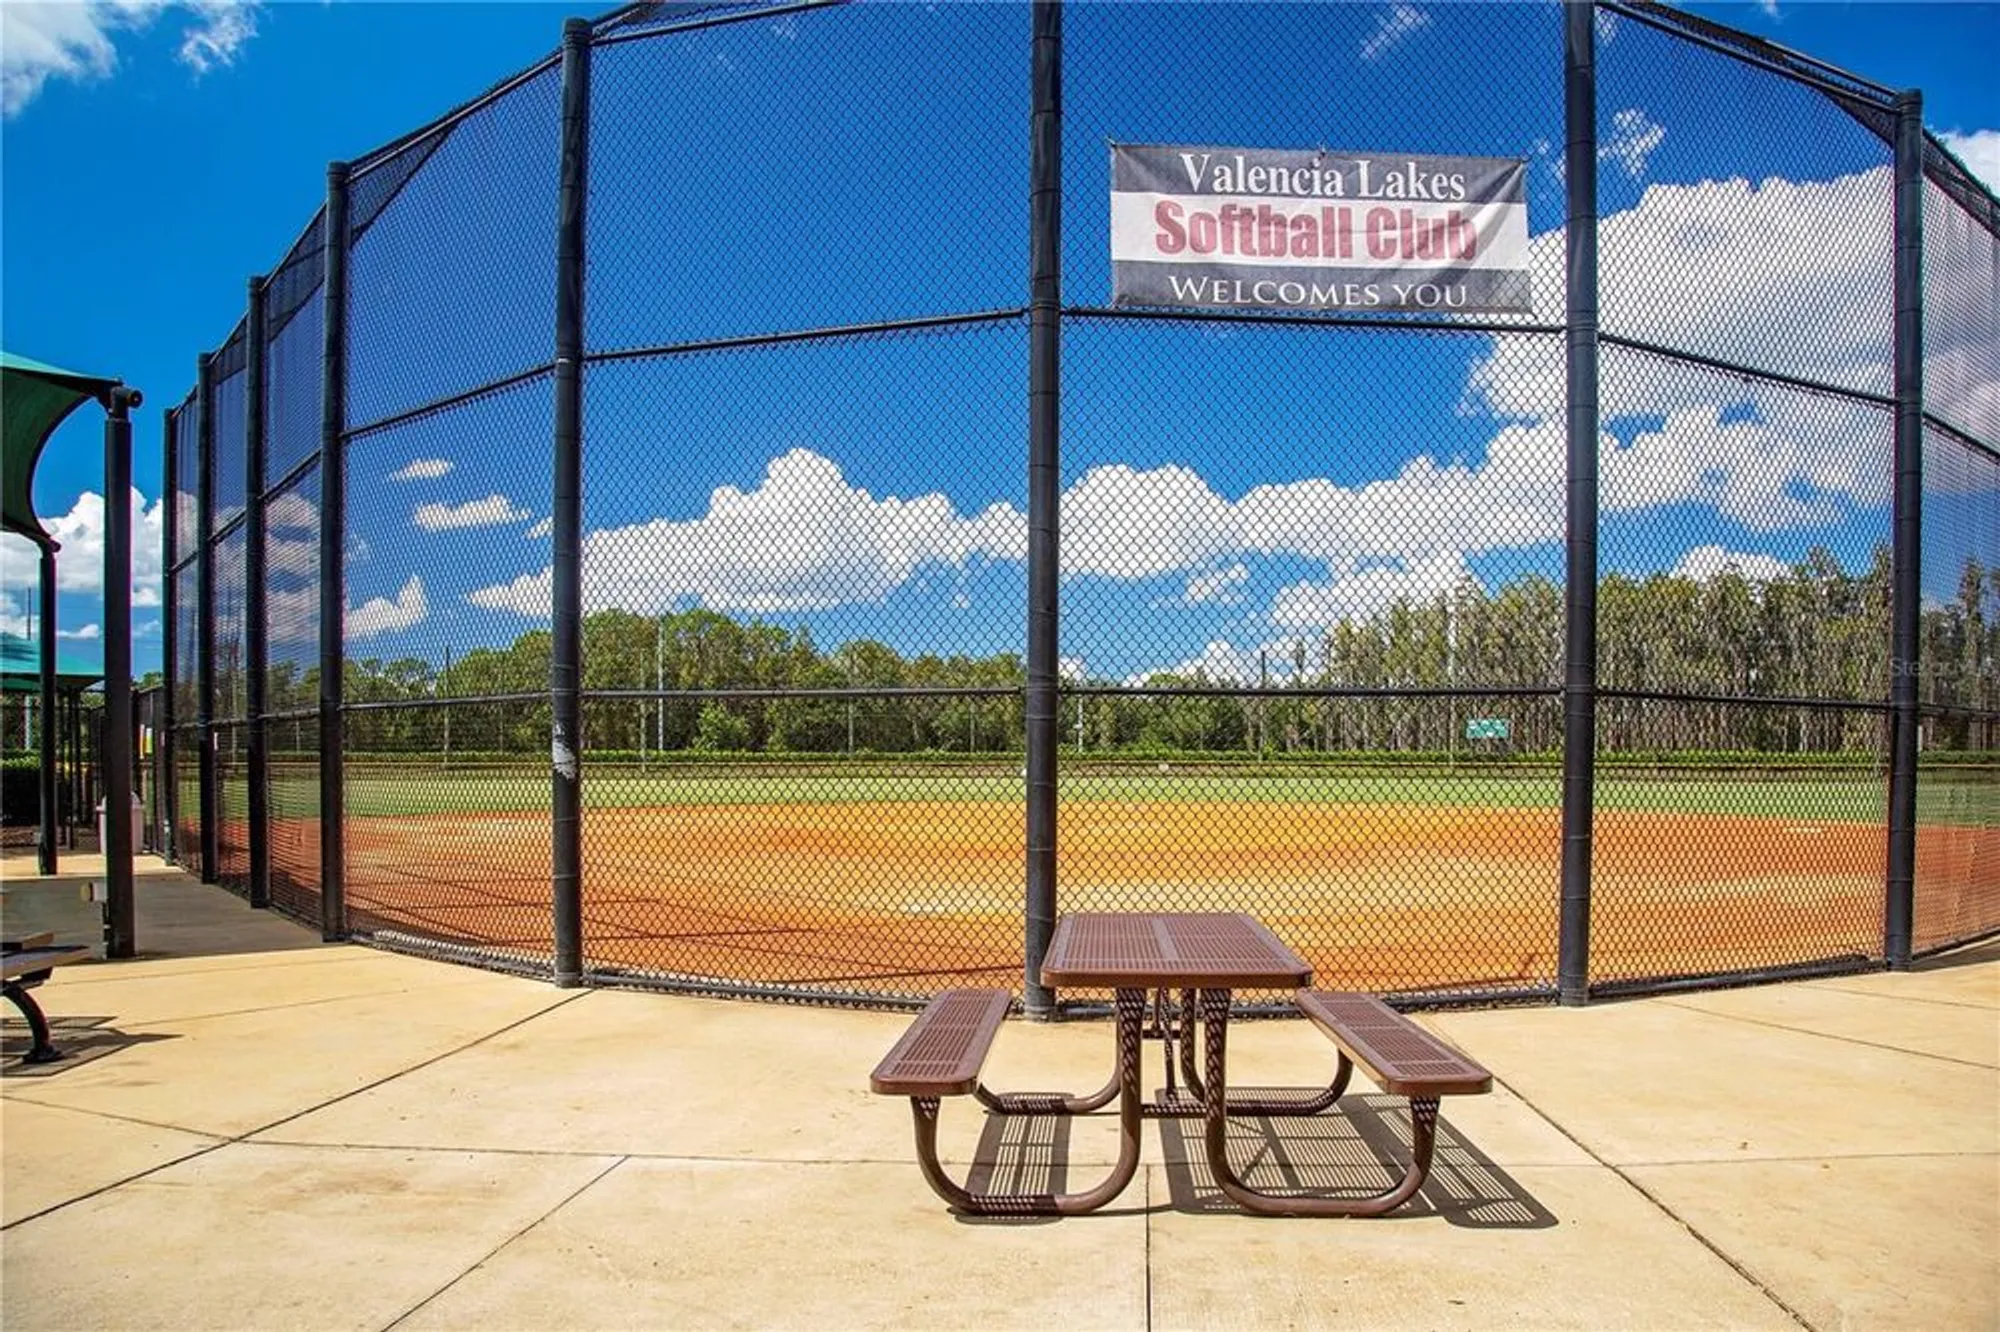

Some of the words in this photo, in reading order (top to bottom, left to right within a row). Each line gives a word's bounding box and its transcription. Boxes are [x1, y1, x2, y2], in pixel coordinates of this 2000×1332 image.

[1179, 153, 1345, 197] Valencia
[1356, 160, 1466, 200] Lakes
[1155, 200, 1353, 258] Softball
[1366, 206, 1478, 261] Club
[1168, 275, 1380, 306] WELCOMES
[1392, 284, 1467, 307] YOU
